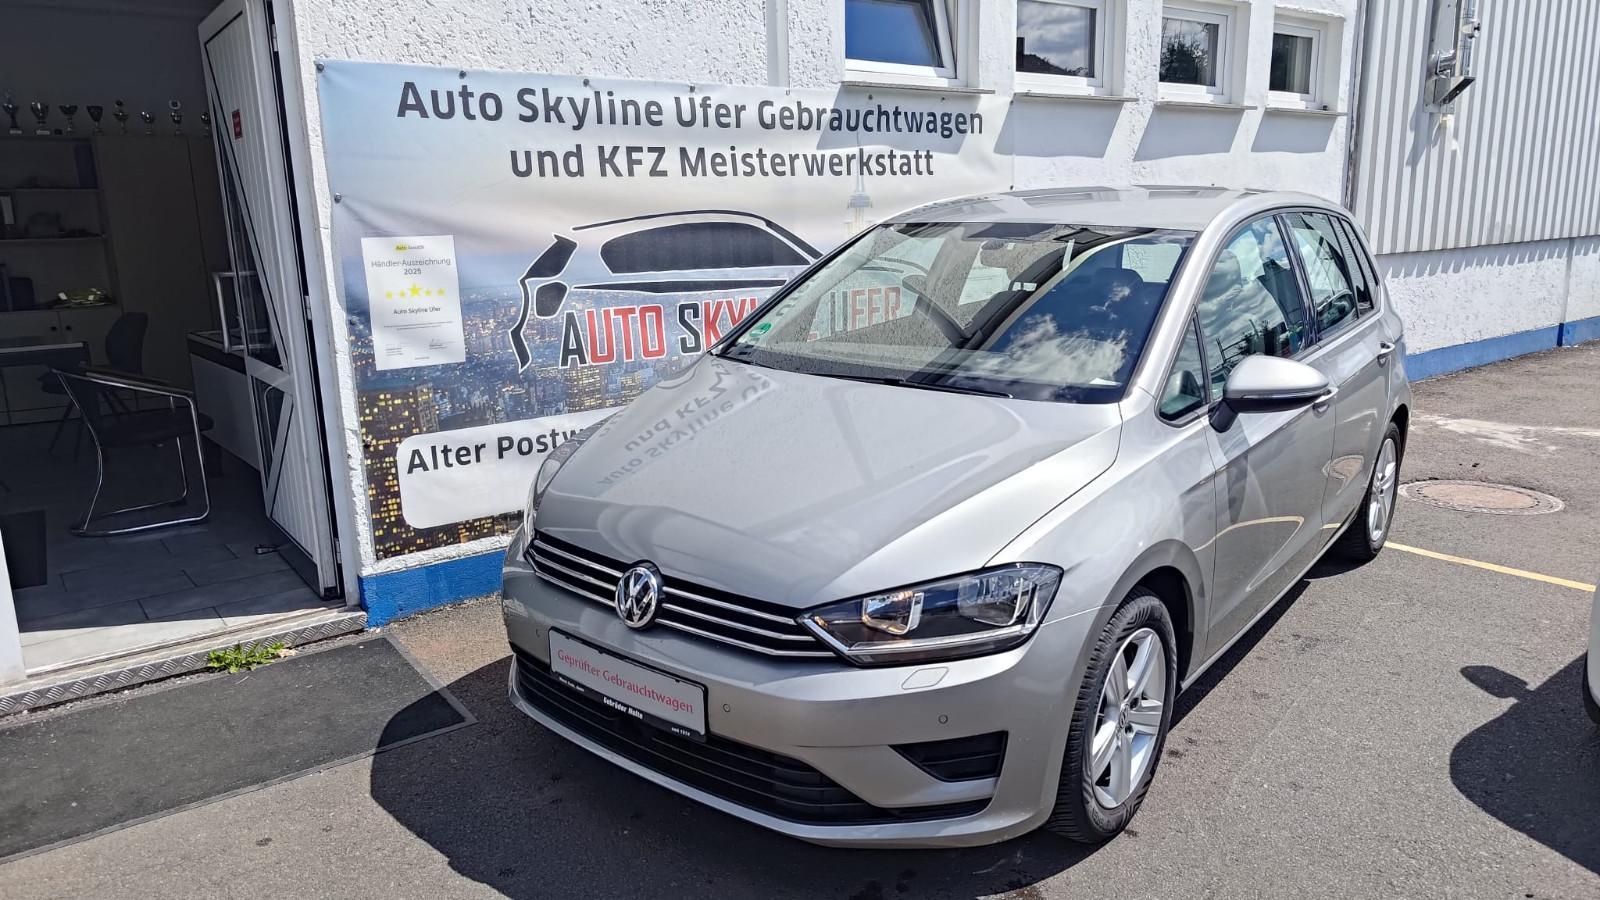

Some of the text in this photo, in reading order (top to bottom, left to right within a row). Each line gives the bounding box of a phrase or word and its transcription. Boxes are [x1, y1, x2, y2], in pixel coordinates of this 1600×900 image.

[397, 81, 983, 139] Auto Skyline Ufer Gebrauchtwagen
[510, 144, 934, 178] und KFZ Meisterwerkstatt
[561, 306, 666, 367] AUTO
[678, 297, 758, 355] SKY
[407, 440, 486, 475] Alter
[557, 650, 600, 676] Geprüfter
[602, 670, 693, 713] Gebrauchtwagen
